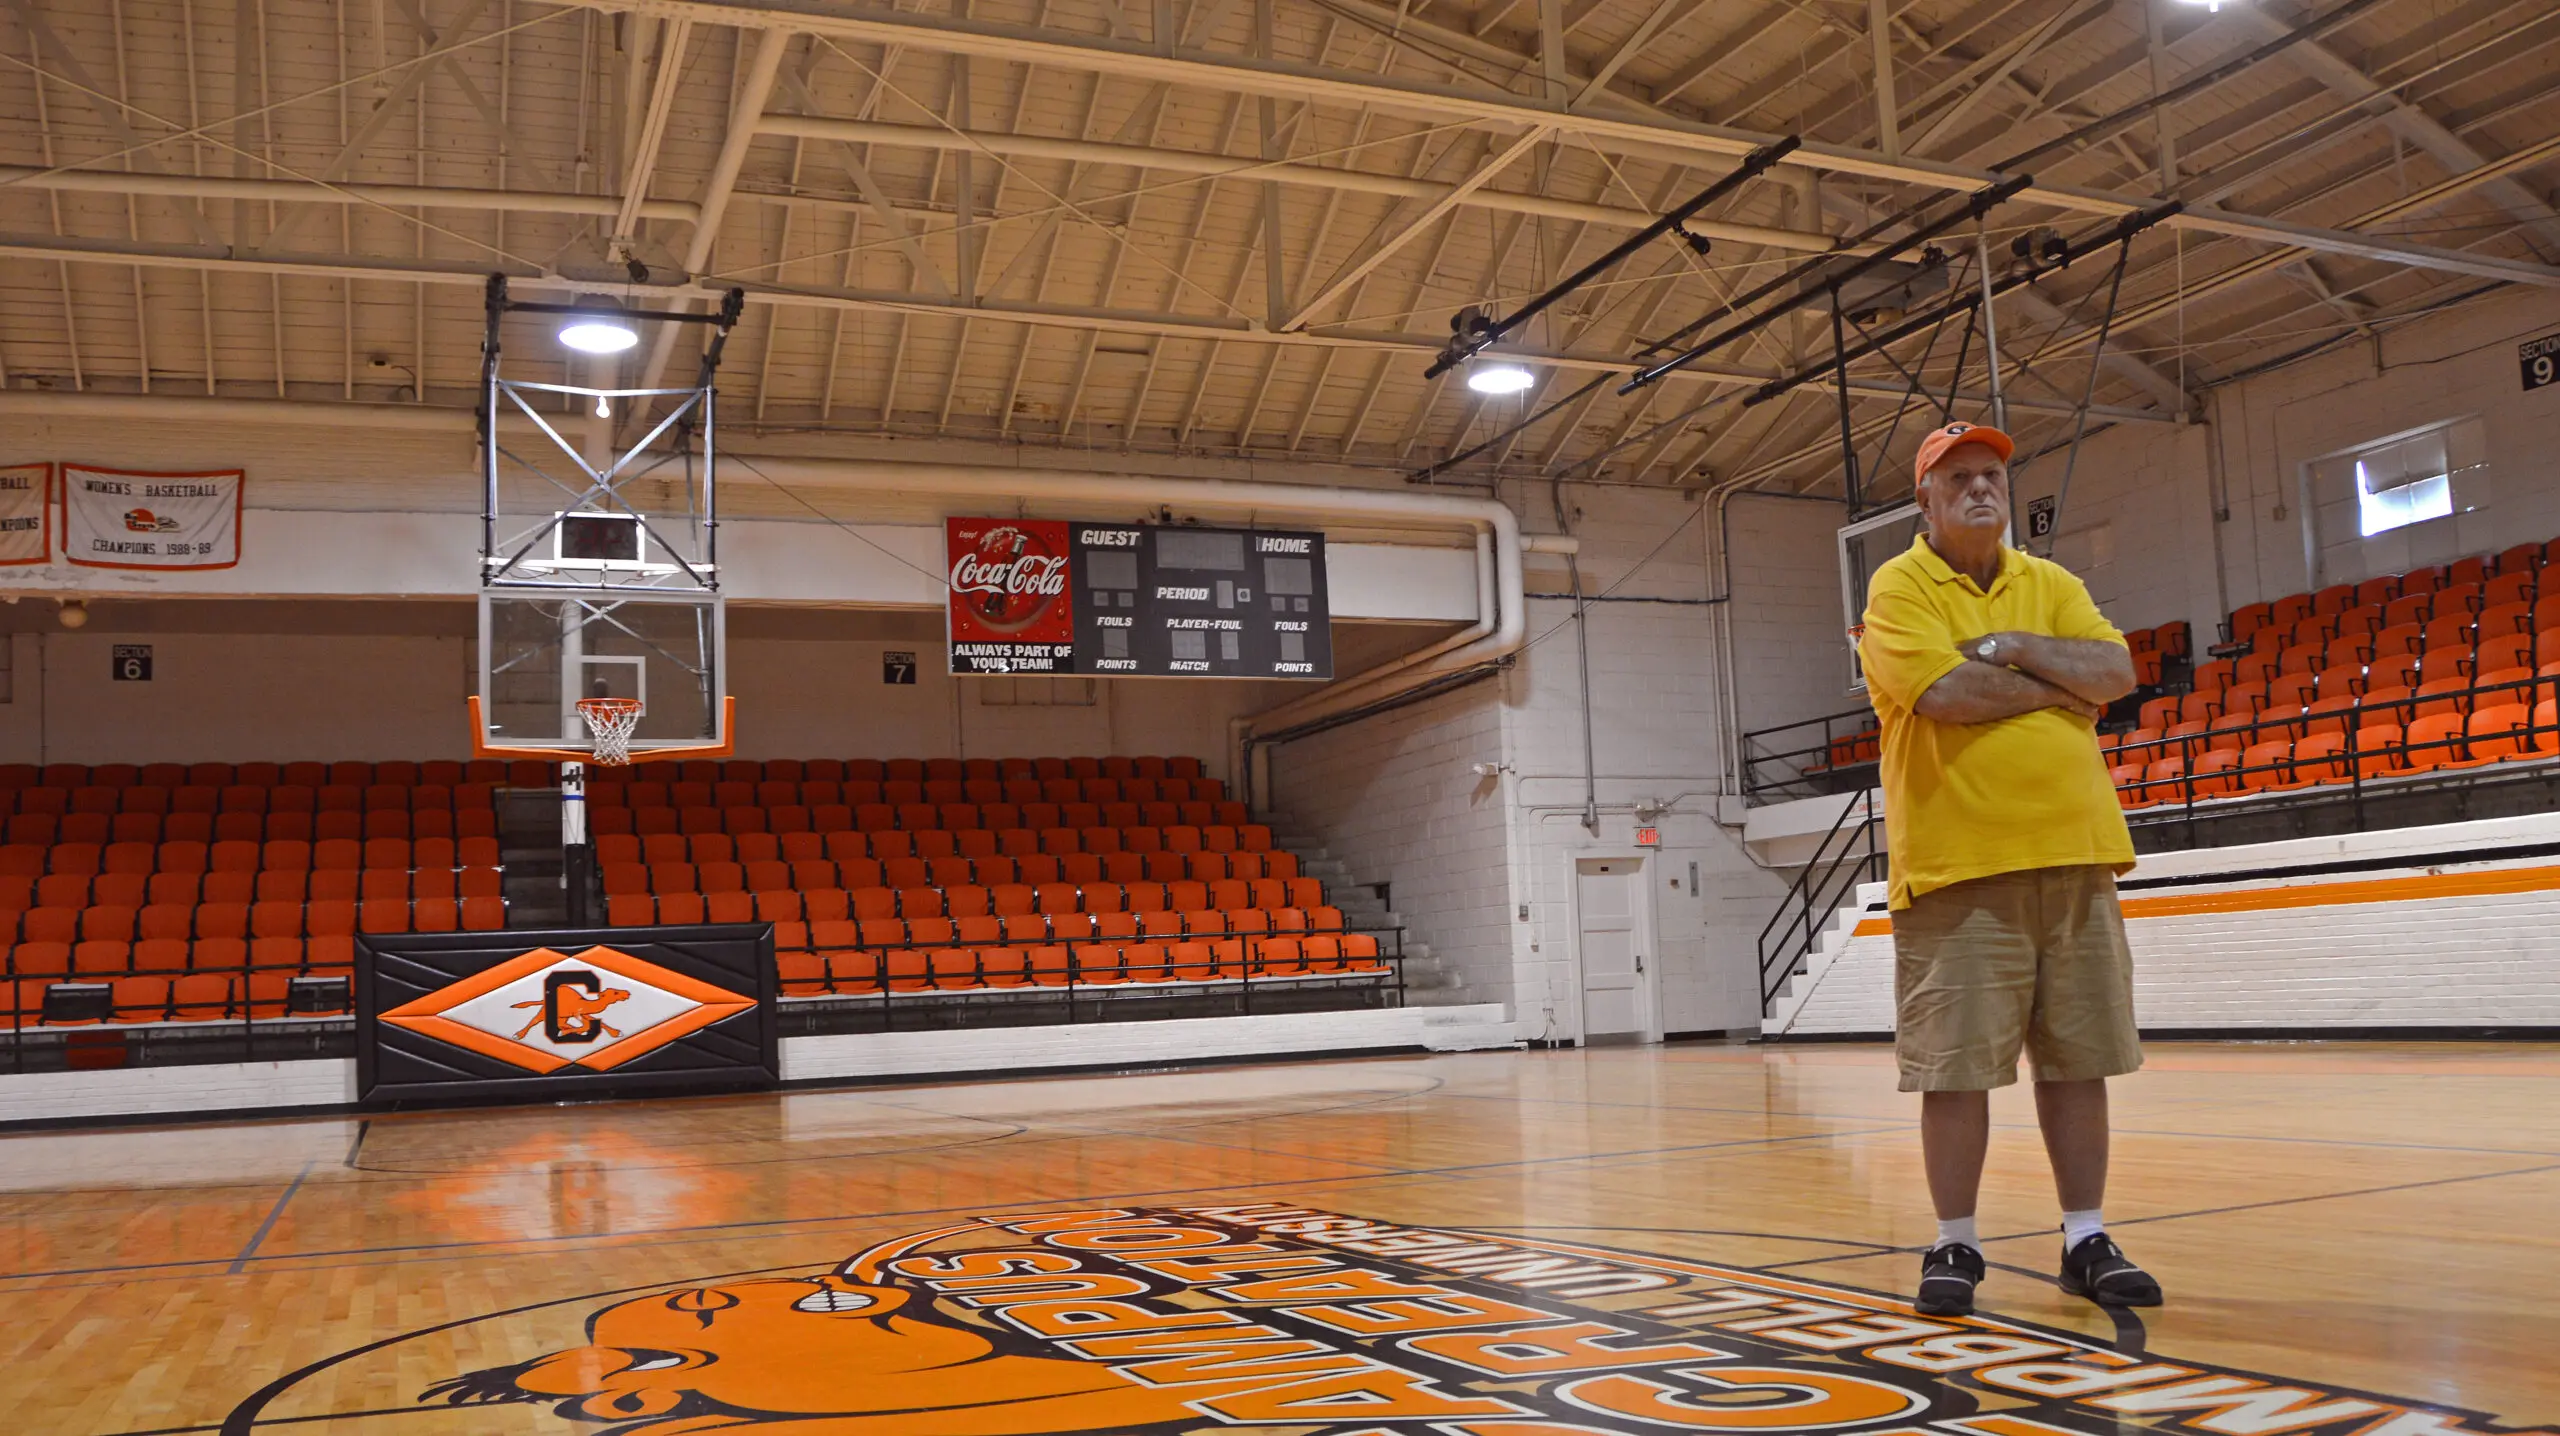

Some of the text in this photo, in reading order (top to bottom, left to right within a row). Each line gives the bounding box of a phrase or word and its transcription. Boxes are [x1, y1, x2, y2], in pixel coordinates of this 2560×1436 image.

[2533, 356, 2554, 385] 9
[146, 484, 218, 497] BASKETBALL
[2037, 512, 2049, 534] 8
[1081, 529, 1140, 546] GUEST
[92, 539, 156, 555] CHAMPIONS
[1261, 538, 1311, 553] HOME
[951, 553, 1068, 595] Coca-Cola
[1156, 587, 1209, 600] PERIOD
[1097, 616, 1133, 626] FOULS
[1166, 619, 1242, 630] PLAYER-FOUL
[1274, 621, 1308, 631] FOULS
[955, 644, 1071, 657] ALWAYS PART OF
[885, 653, 915, 664] SECTION
[970, 657, 1053, 670] YOUR TEAM!
[1096, 660, 1137, 670] POINTS
[124, 658, 141, 678] 6
[1170, 662, 1209, 671] MATCH
[1275, 663, 1312, 673] POINTS
[893, 665, 907, 682] 7
[1168, 1203, 1679, 1298] UNIVERSITY
